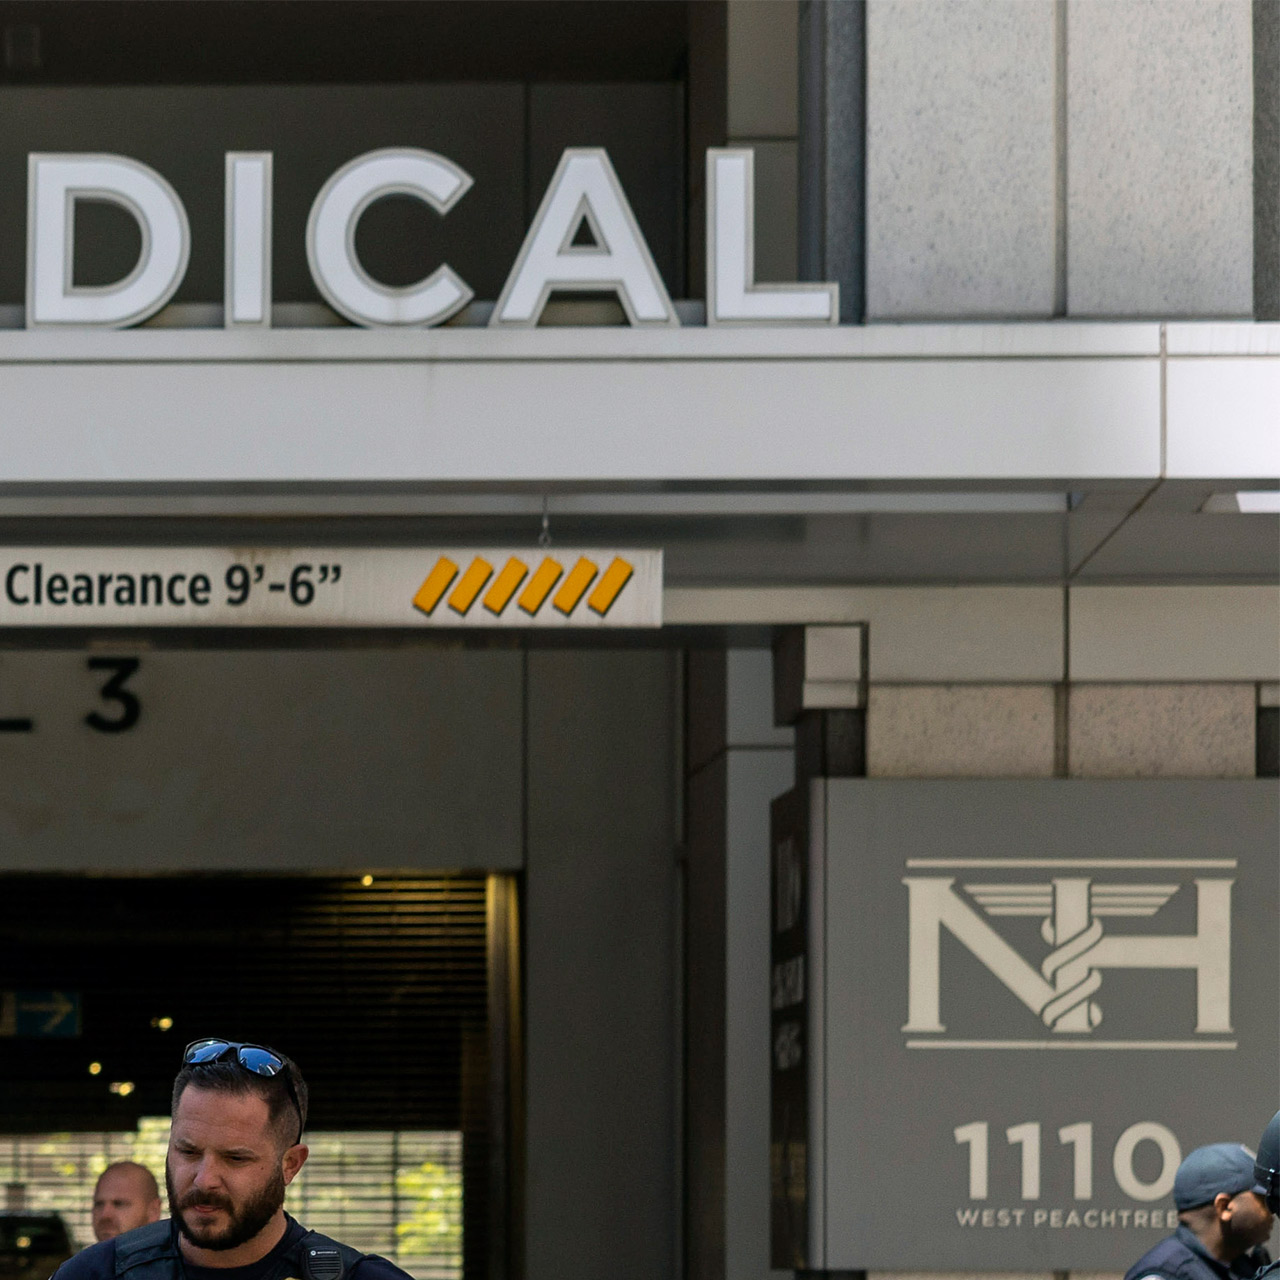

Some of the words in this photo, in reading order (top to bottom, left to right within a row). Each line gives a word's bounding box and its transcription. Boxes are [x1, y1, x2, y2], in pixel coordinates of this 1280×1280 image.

[5, 562, 212, 606] Clearance
[85, 655, 142, 734] 3
[953, 1121, 1182, 1202] 1110
[956, 1207, 1024, 1228] WEST
[1034, 1207, 1179, 1229] PEACHTREE
